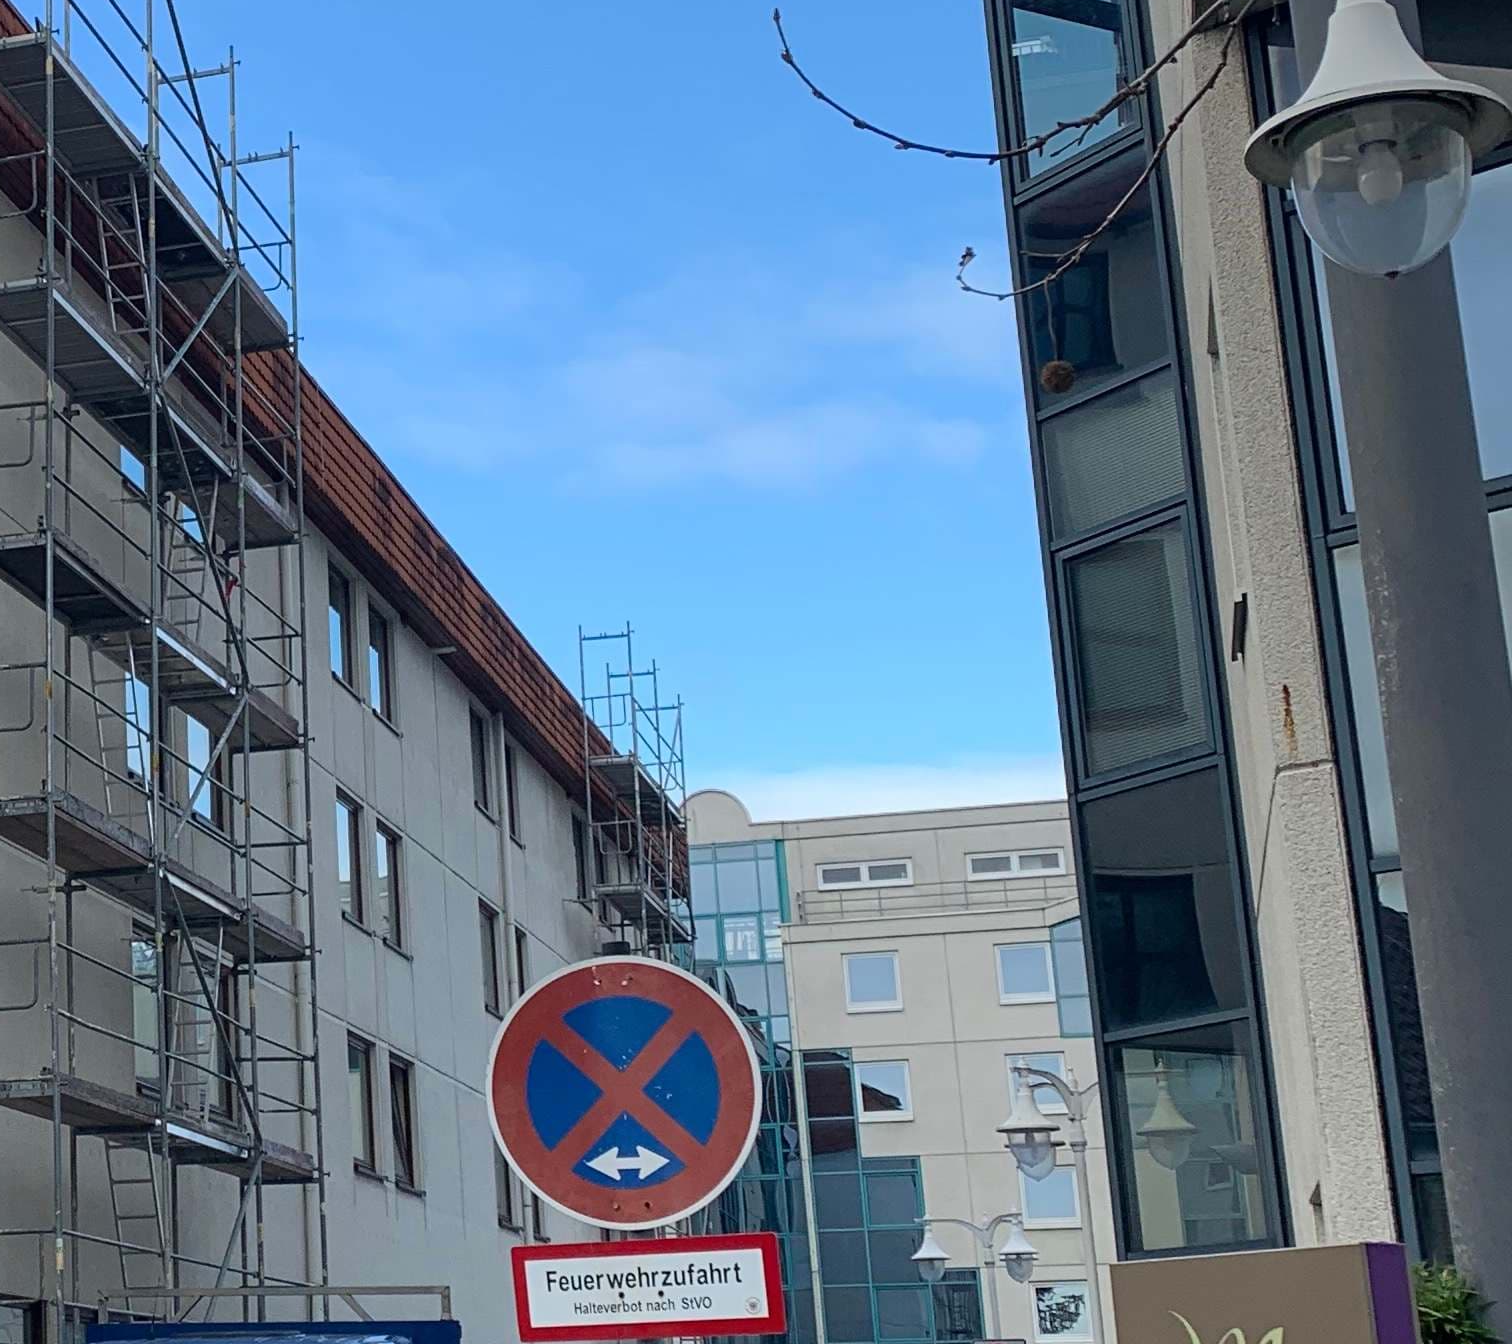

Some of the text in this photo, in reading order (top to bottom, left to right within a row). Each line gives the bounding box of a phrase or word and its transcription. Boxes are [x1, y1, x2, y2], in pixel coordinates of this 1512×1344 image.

[546, 1262, 743, 1292] Feuerwehrzufahrt
[574, 1296, 713, 1315] Halteverbot nach StVO
